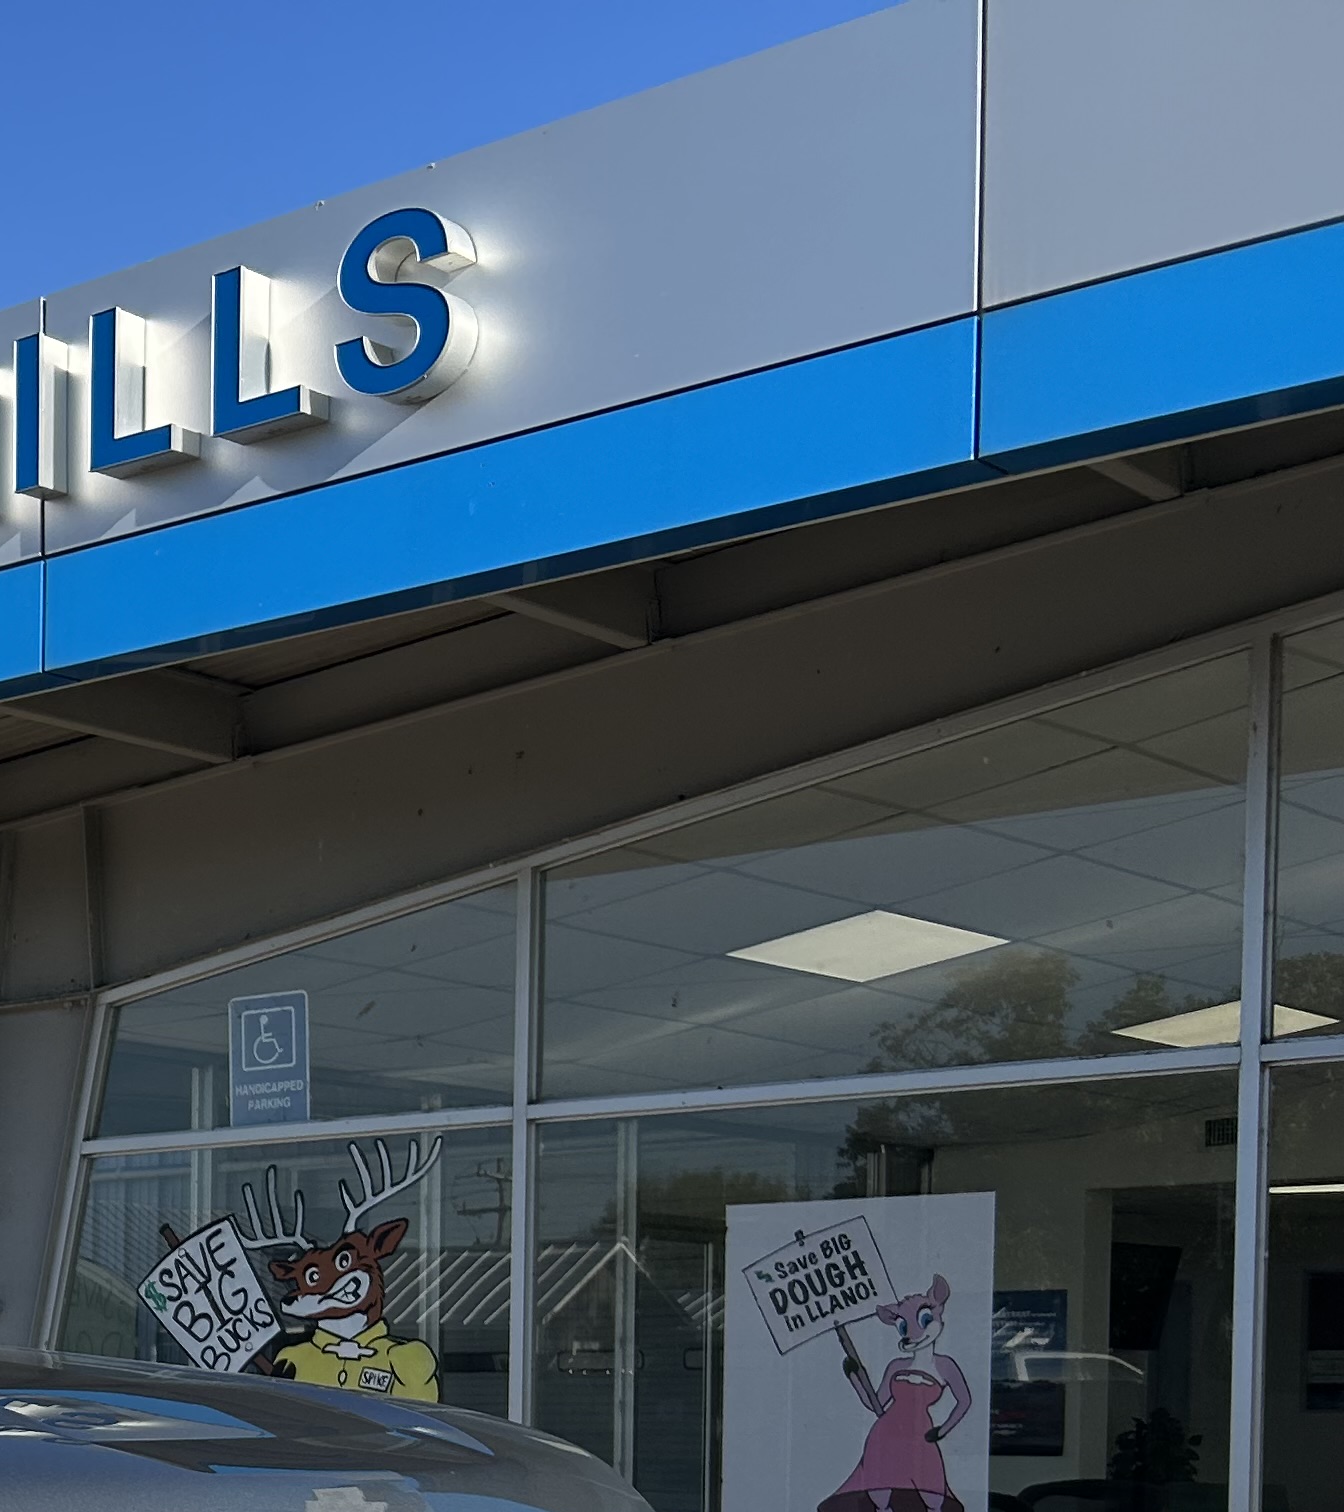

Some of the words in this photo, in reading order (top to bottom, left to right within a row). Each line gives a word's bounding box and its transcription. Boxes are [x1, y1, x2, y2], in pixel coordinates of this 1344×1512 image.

[235, 1079, 305, 1097] HANDICAPPED
[247, 1096, 291, 1111] PARKING
[158, 1228, 237, 1302] SAVE
[773, 1251, 819, 1279] Save
[819, 1233, 852, 1259] BIG
[172, 1268, 249, 1343] BIG
[768, 1249, 869, 1316] DOUGH
[804, 1277, 878, 1323] LLANO!
[200, 1297, 275, 1371] BUCKS
[362, 1370, 389, 1388] SPIKE
